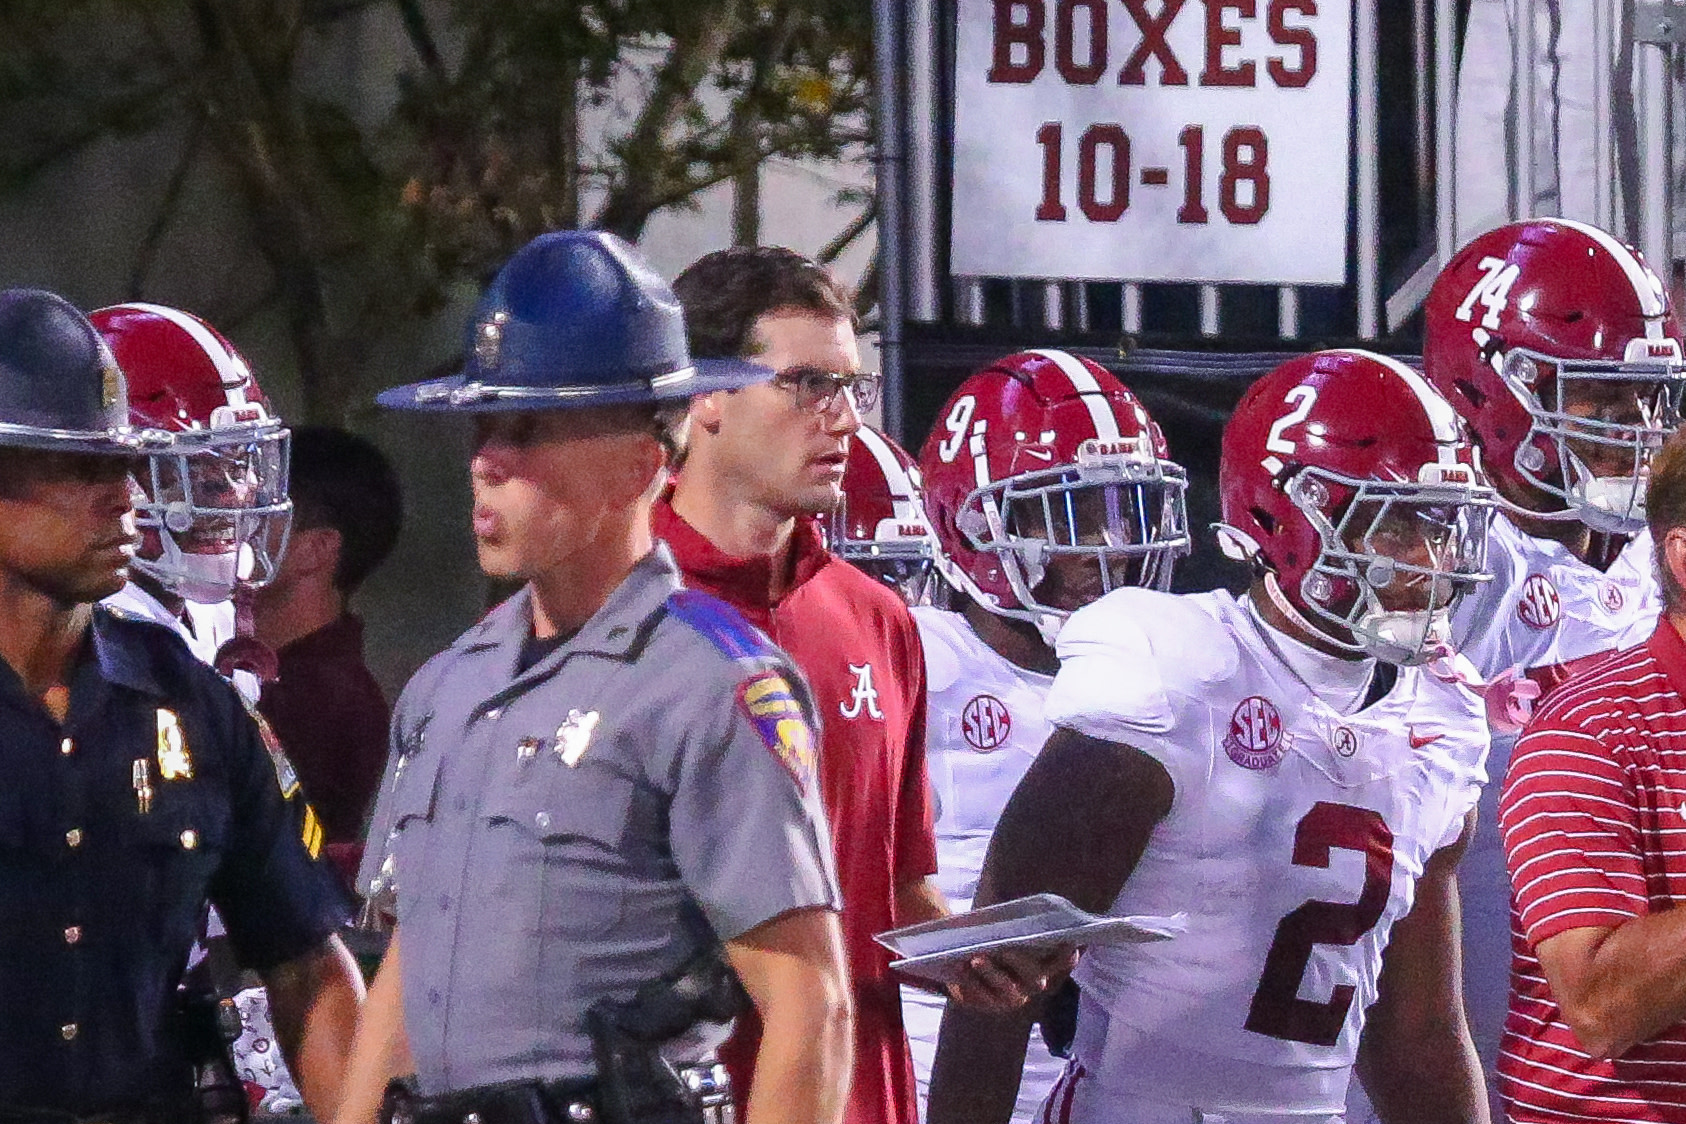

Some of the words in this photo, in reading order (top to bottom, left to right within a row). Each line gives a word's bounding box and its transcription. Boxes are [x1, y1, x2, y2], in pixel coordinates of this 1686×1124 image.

[986, 0, 1318, 88] BOXES
[1035, 121, 1270, 225] 10-18
[1455, 255, 1520, 330] 74
[1266, 385, 1318, 454] 2
[1244, 801, 1393, 1046] 2
